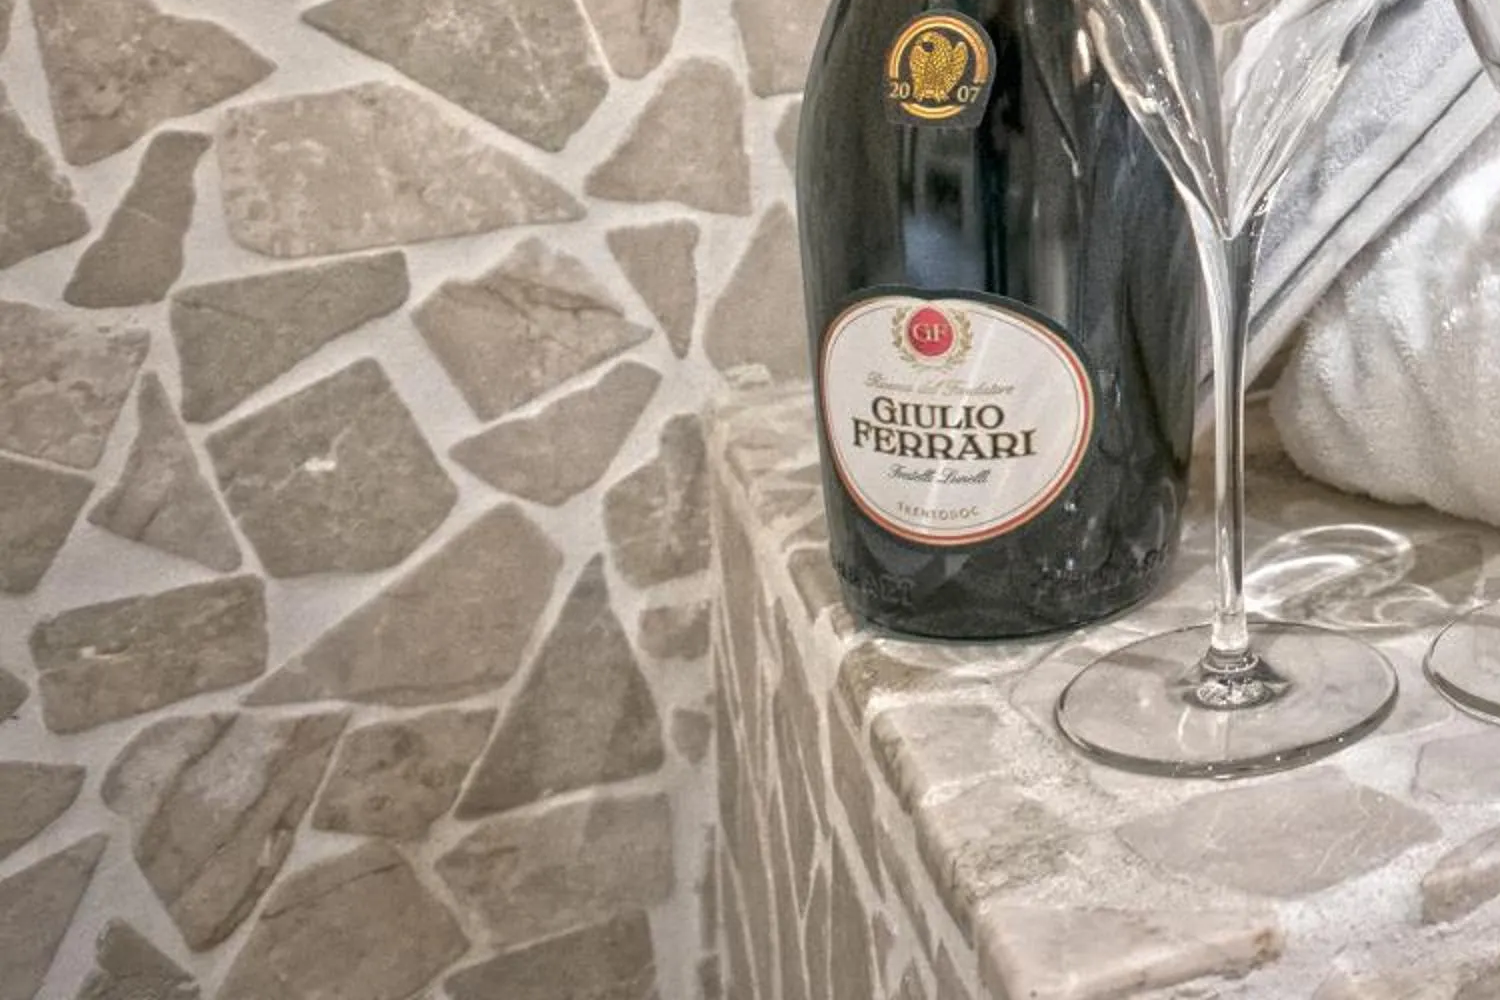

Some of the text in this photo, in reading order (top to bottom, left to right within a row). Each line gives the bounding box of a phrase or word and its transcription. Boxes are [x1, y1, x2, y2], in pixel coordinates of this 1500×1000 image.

[913, 322, 945, 343] GF
[871, 396, 1005, 430] GIULIO
[852, 417, 1037, 461] FERRARI
